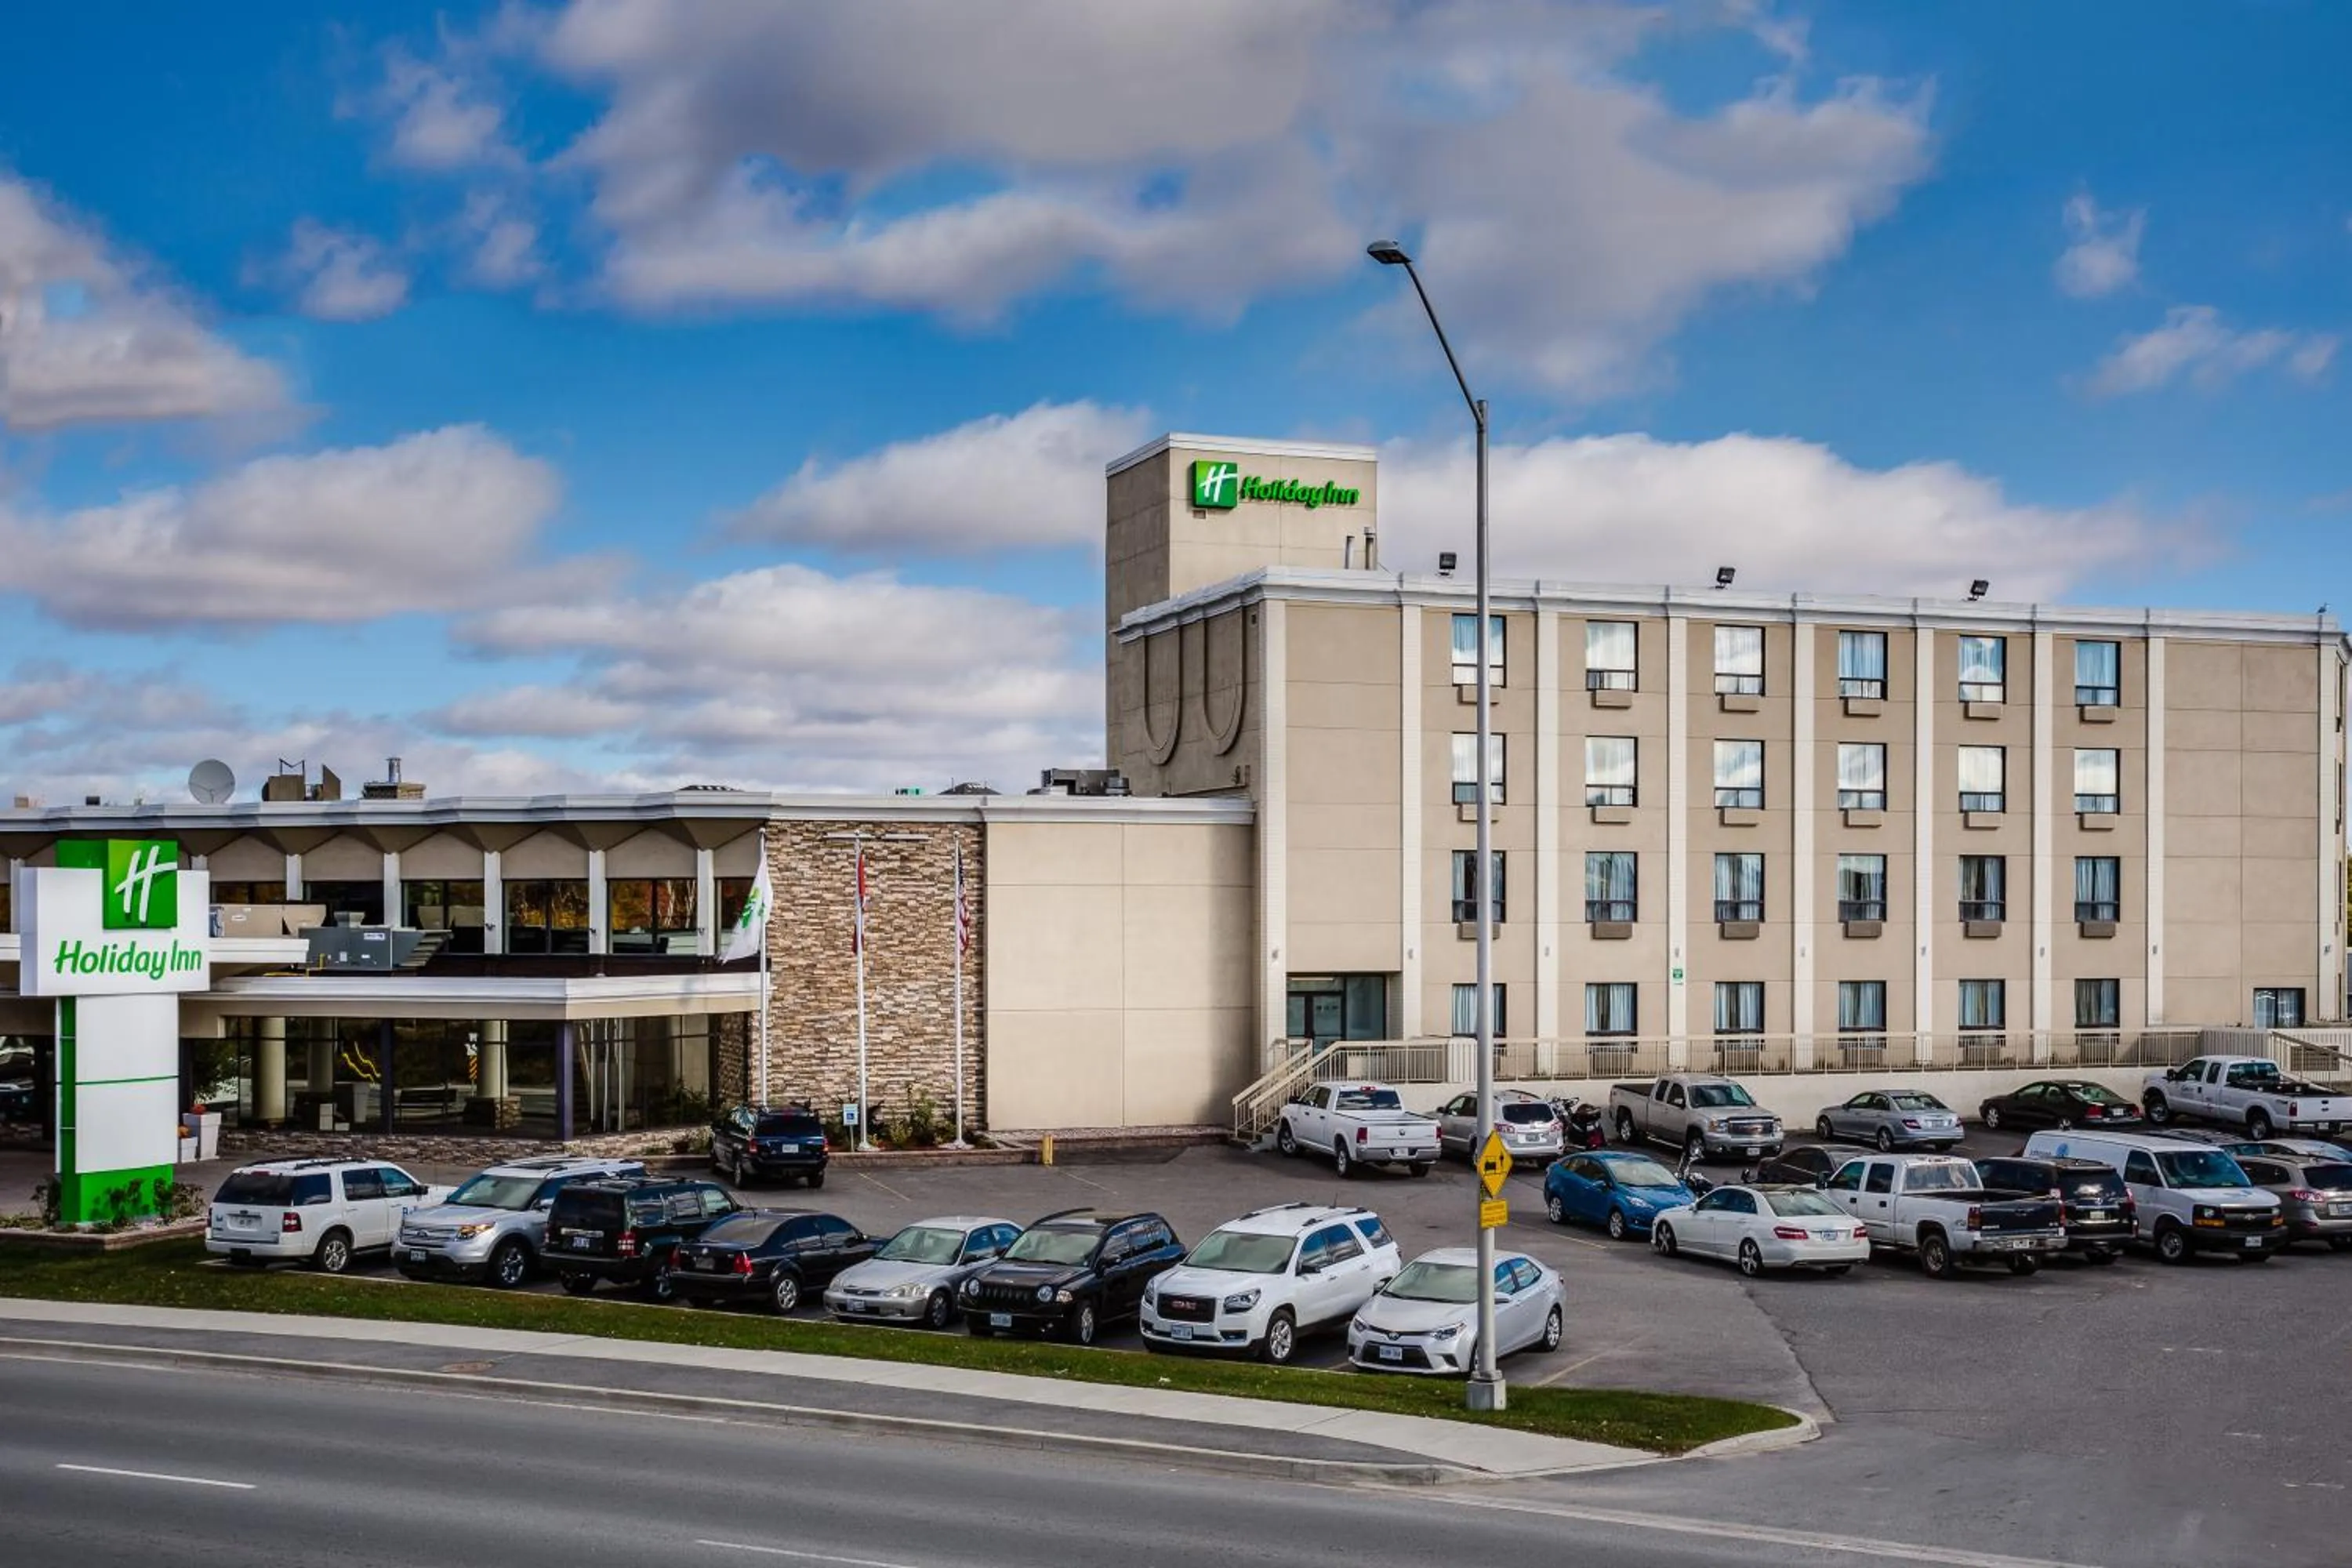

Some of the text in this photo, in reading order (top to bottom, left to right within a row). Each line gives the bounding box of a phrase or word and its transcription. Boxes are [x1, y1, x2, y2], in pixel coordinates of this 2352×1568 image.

[1241, 476, 1360, 509] Holiday Inn
[114, 845, 177, 923] H
[53, 938, 202, 980] Holiday Inn
